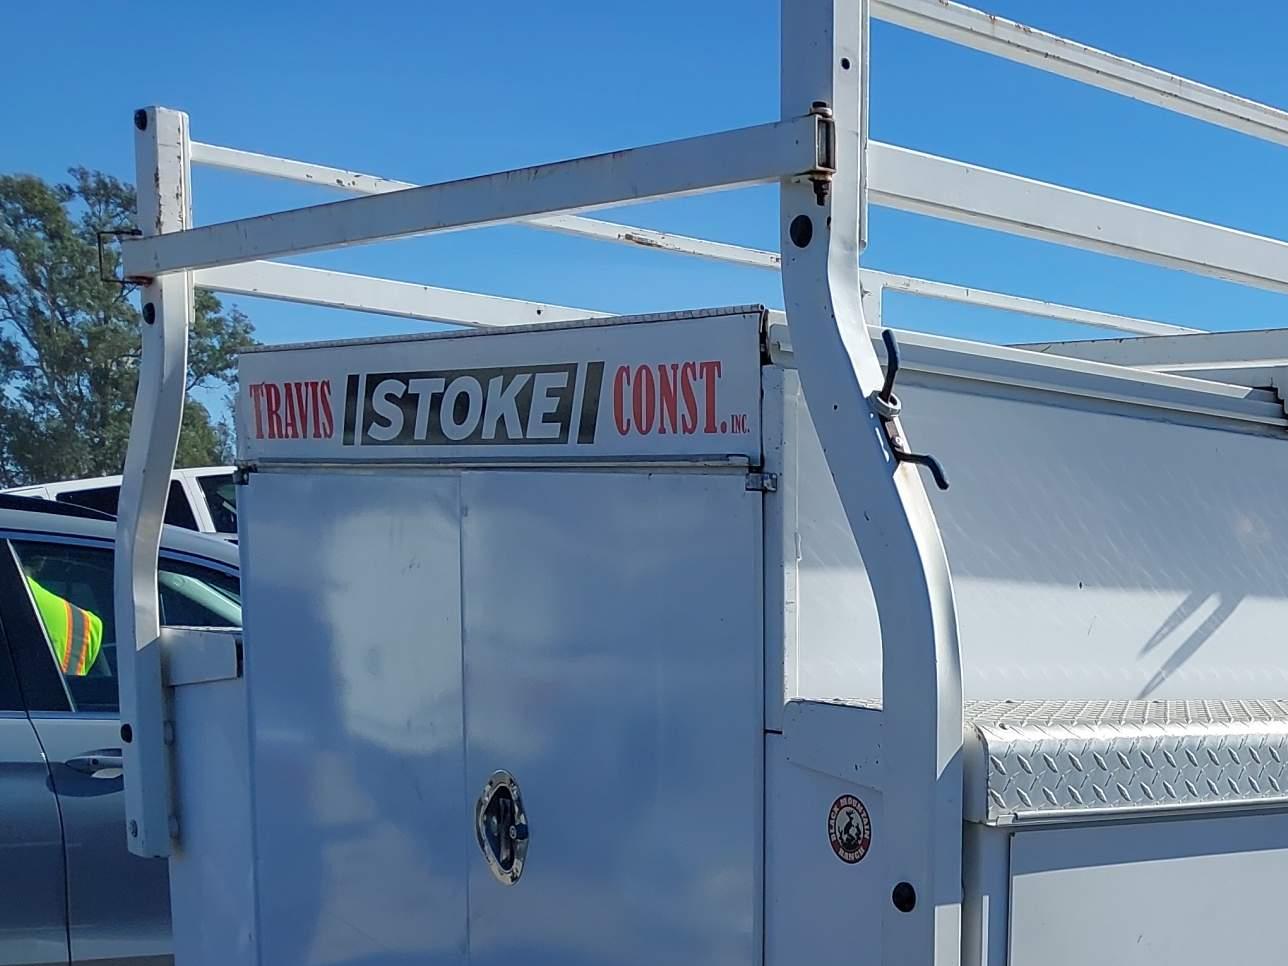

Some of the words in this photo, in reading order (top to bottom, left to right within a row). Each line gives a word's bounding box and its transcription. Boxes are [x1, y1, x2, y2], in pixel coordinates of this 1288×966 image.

[249, 379, 335, 439] TRAVIS
[366, 371, 569, 441] STOKE
[612, 360, 728, 436] CONST.
[730, 413, 750, 434] INC.
[829, 805, 840, 841] BLACK
[840, 796, 870, 839] MOUNTAIN
[838, 846, 865, 861] RANCH
